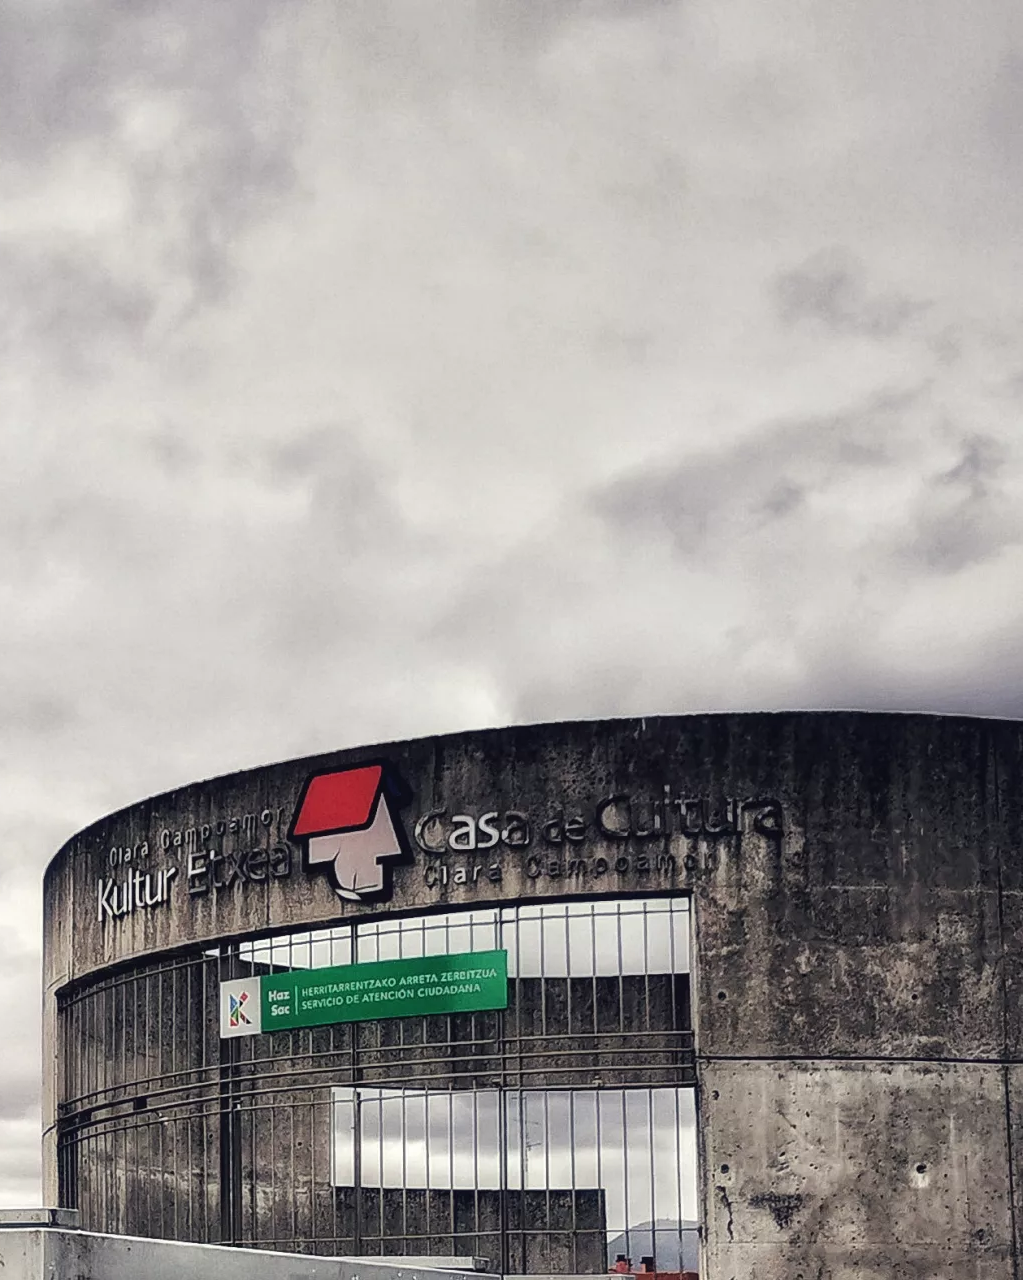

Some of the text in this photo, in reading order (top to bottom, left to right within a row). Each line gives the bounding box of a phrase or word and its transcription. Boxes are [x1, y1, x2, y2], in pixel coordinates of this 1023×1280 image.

[414, 784, 783, 853] Casa de Cultura
[109, 807, 284, 867] Clara Campoamor
[98, 842, 291, 922] Kultur Etxea
[424, 848, 718, 888] Clara Campoamor
[268, 989, 290, 1003] Haz
[301, 968, 498, 998] HERRITARRENTZAKO ARRETA ZERBITZUA
[301, 983, 481, 1010] SERVICIO DE ATENCIÓN CIUDADANA
[270, 1004, 290, 1017] Sac
